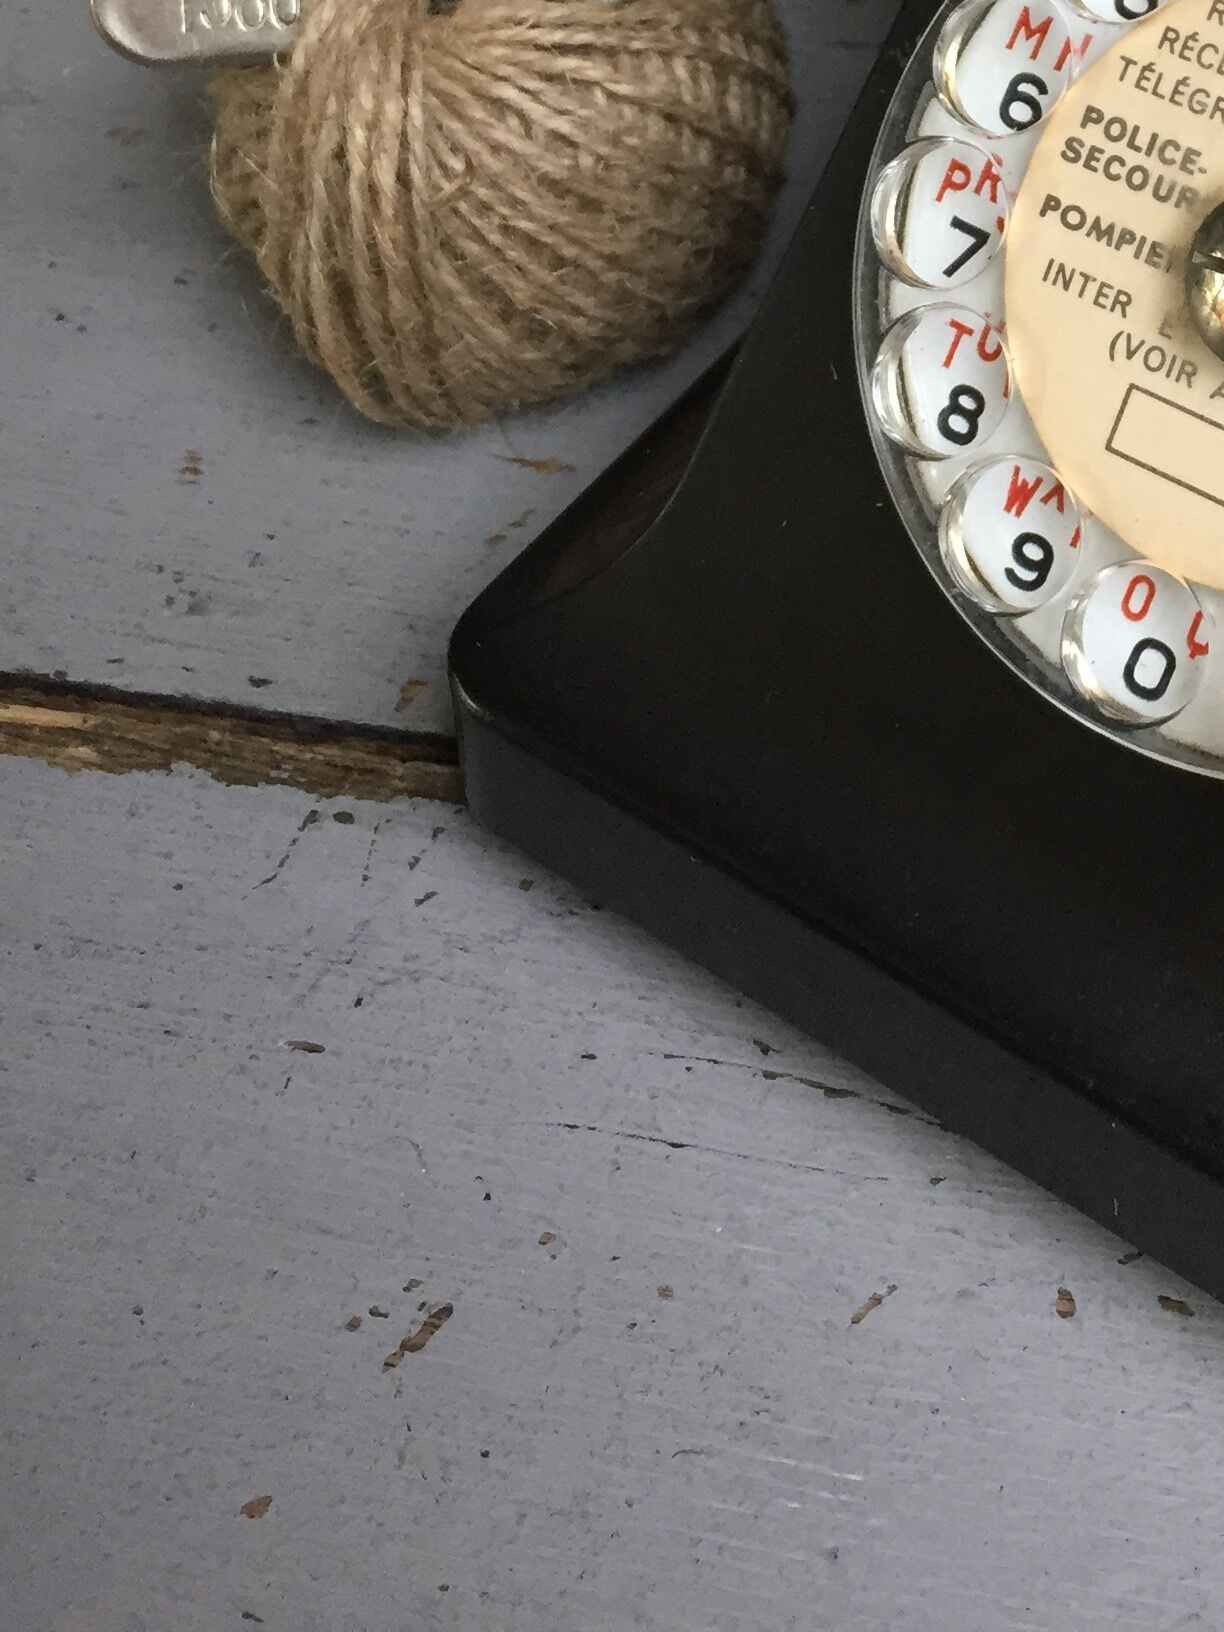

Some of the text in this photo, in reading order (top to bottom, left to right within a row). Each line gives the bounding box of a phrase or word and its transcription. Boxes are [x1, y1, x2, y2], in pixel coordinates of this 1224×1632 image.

[999, 72, 1049, 132] 6
[1080, 104, 1207, 176] POLICE-
[1061, 136, 1201, 210] SECOUR
[942, 215, 991, 278] 7
[1039, 193, 1172, 273] POMPIE
[1042, 258, 1133, 319] INTER
[1108, 330, 1198, 388] (VOIR
[937, 384, 985, 446] 8
[1003, 531, 1055, 592] 9
